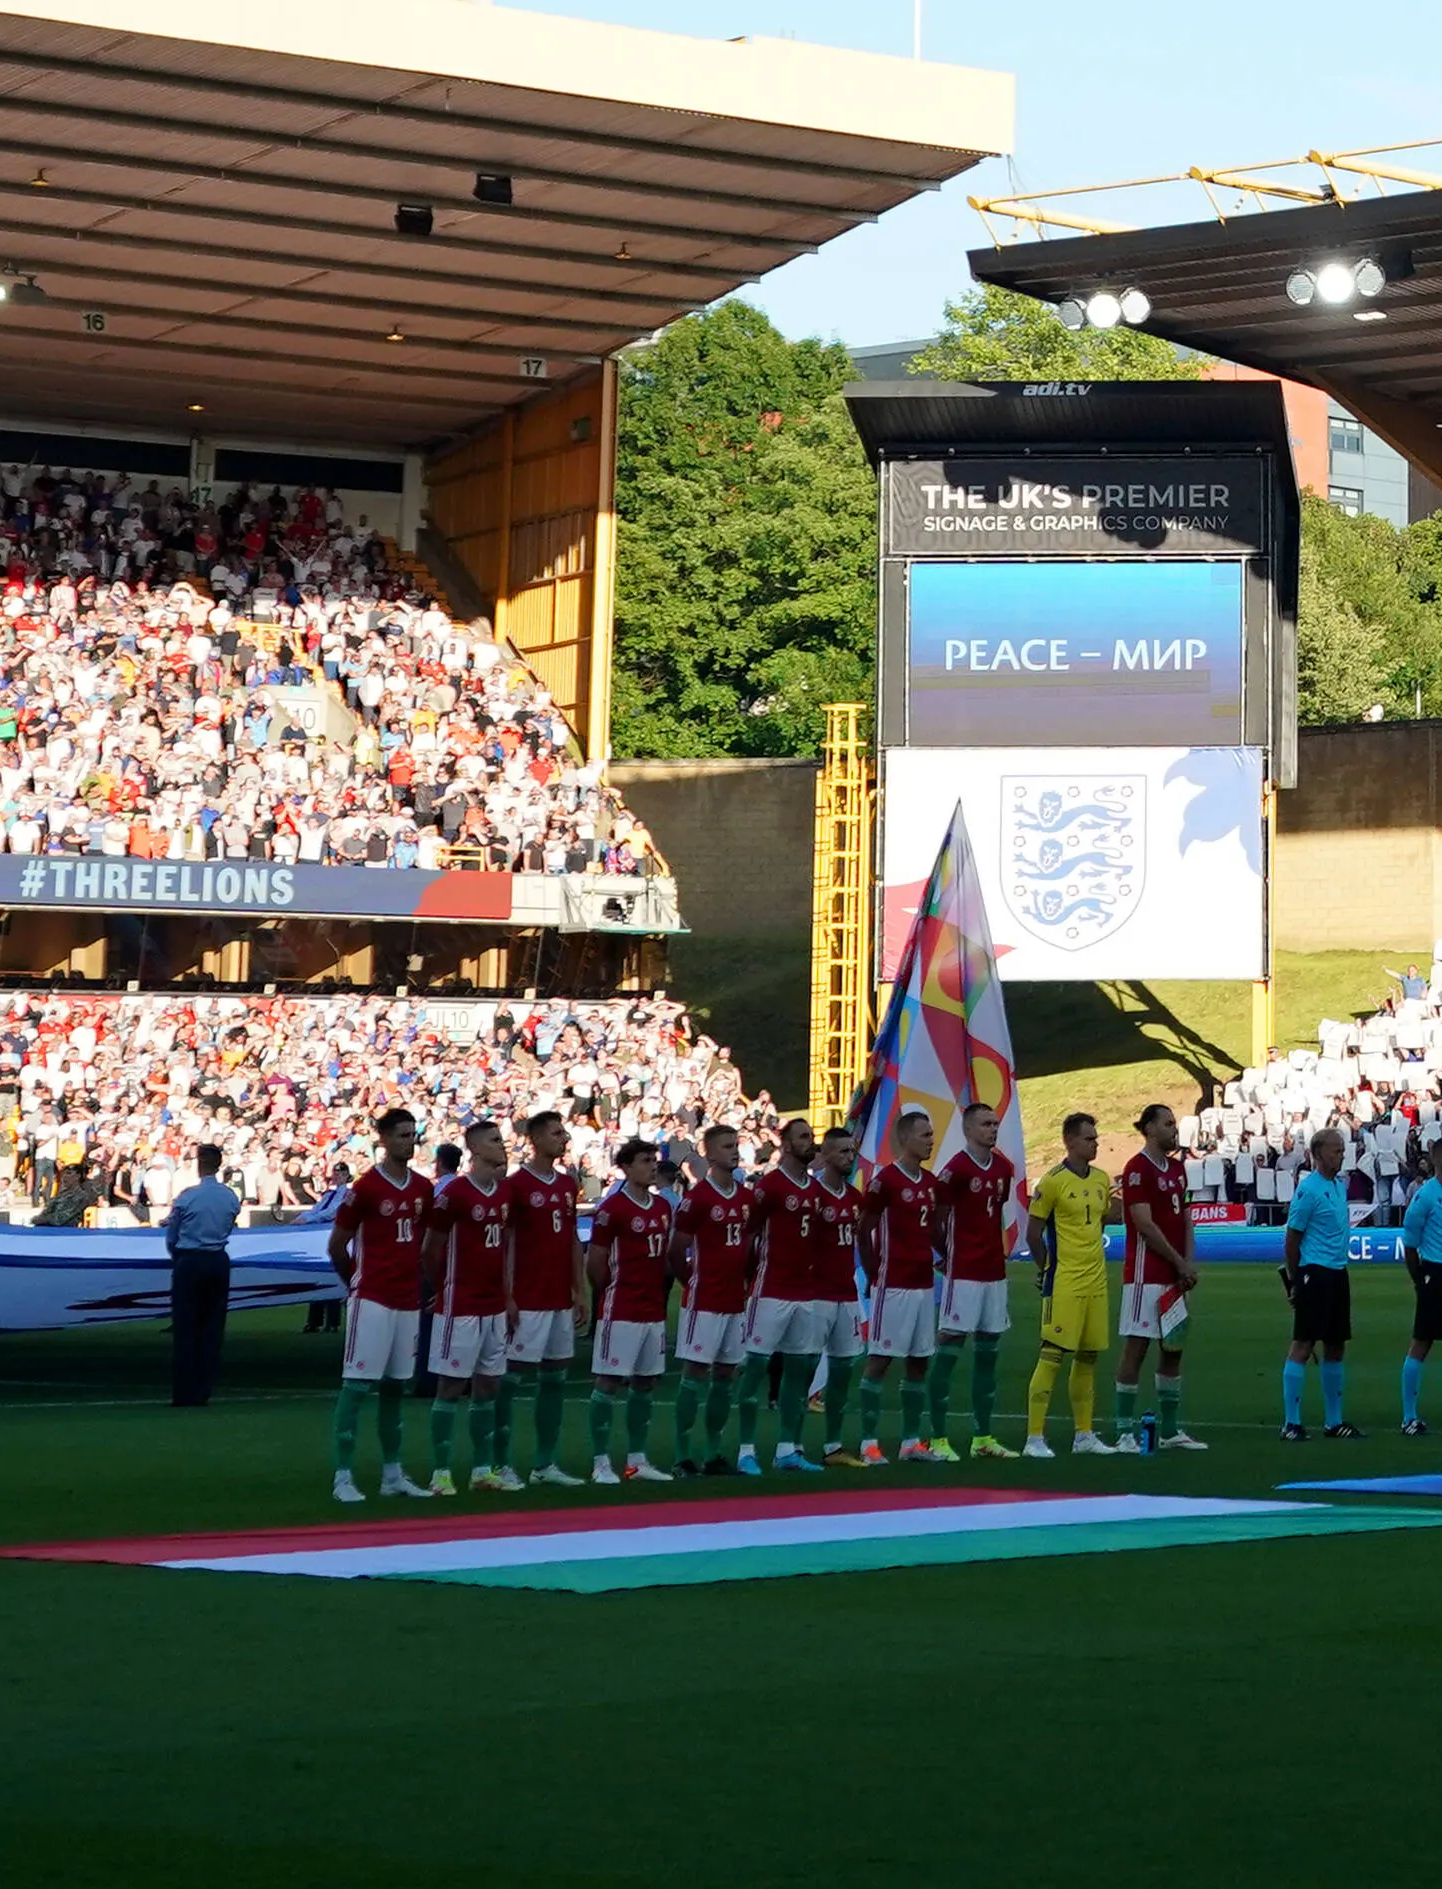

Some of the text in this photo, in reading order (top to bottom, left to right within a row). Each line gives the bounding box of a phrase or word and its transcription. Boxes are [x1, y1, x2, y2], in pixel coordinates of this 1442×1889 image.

[82, 314, 104, 332] 16
[523, 359, 543, 375] 17
[1022, 382, 1092, 396] adi.tv
[921, 484, 1230, 509] THE UK'S PREMIER
[924, 515, 1230, 531] SIGNAGE & GRAPHICS COMPANY
[945, 639, 1070, 671] PEACE
[1112, 639, 1208, 671] МИР
[19, 860, 295, 905] #THREELIONS
[919, 1204, 929, 1227] 2
[1085, 1204, 1091, 1225] 1
[1171, 1193, 1180, 1215] 9
[396, 1217, 413, 1243] 10
[552, 1209, 562, 1233] 6
[800, 1214, 811, 1238] 5
[484, 1223, 501, 1249] 20
[647, 1233, 662, 1258] 17
[726, 1223, 742, 1247] 13
[838, 1223, 853, 1246] 18
